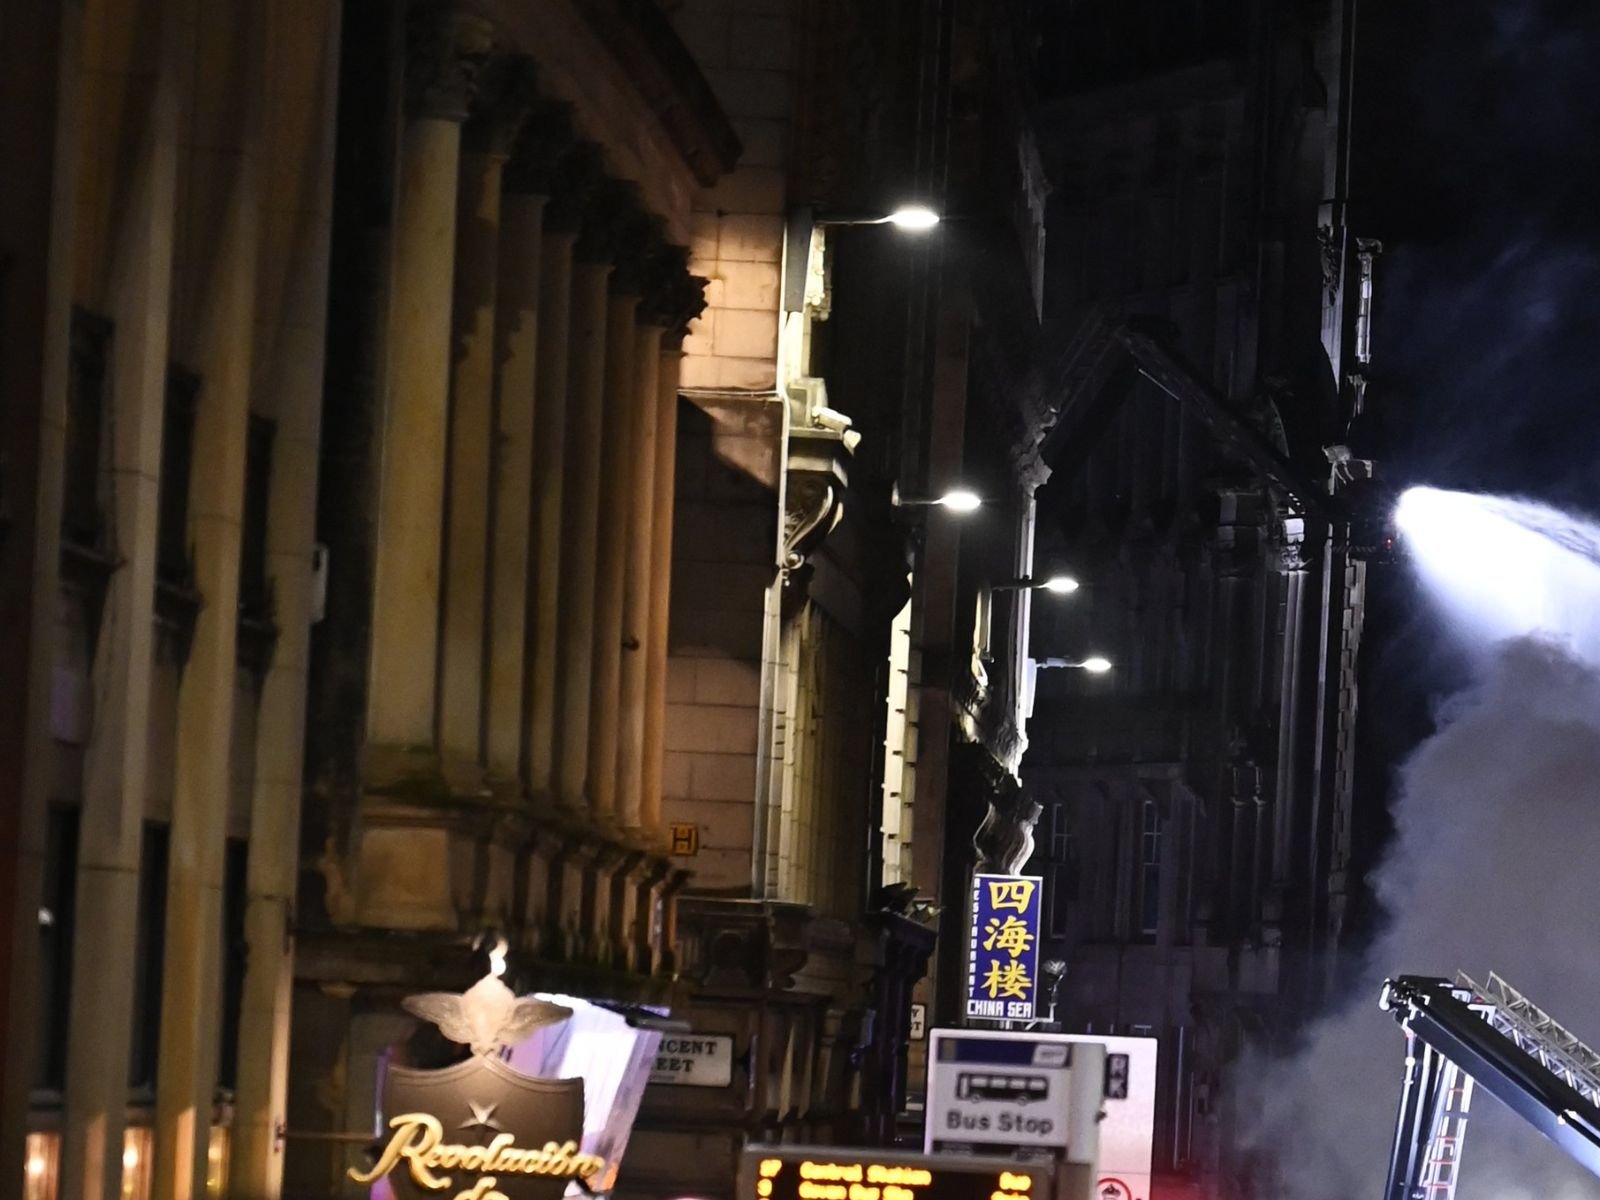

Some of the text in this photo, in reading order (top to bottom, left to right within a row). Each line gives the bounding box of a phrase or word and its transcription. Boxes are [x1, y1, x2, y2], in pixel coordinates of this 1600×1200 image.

[968, 878, 981, 997] RESTAURANT
[980, 880, 1035, 1000] 四海楼
[966, 1000, 1032, 1018] CHINA SEA
[346, 1112, 604, 1189] Revolución
[946, 1110, 1054, 1136] Bus Stop
